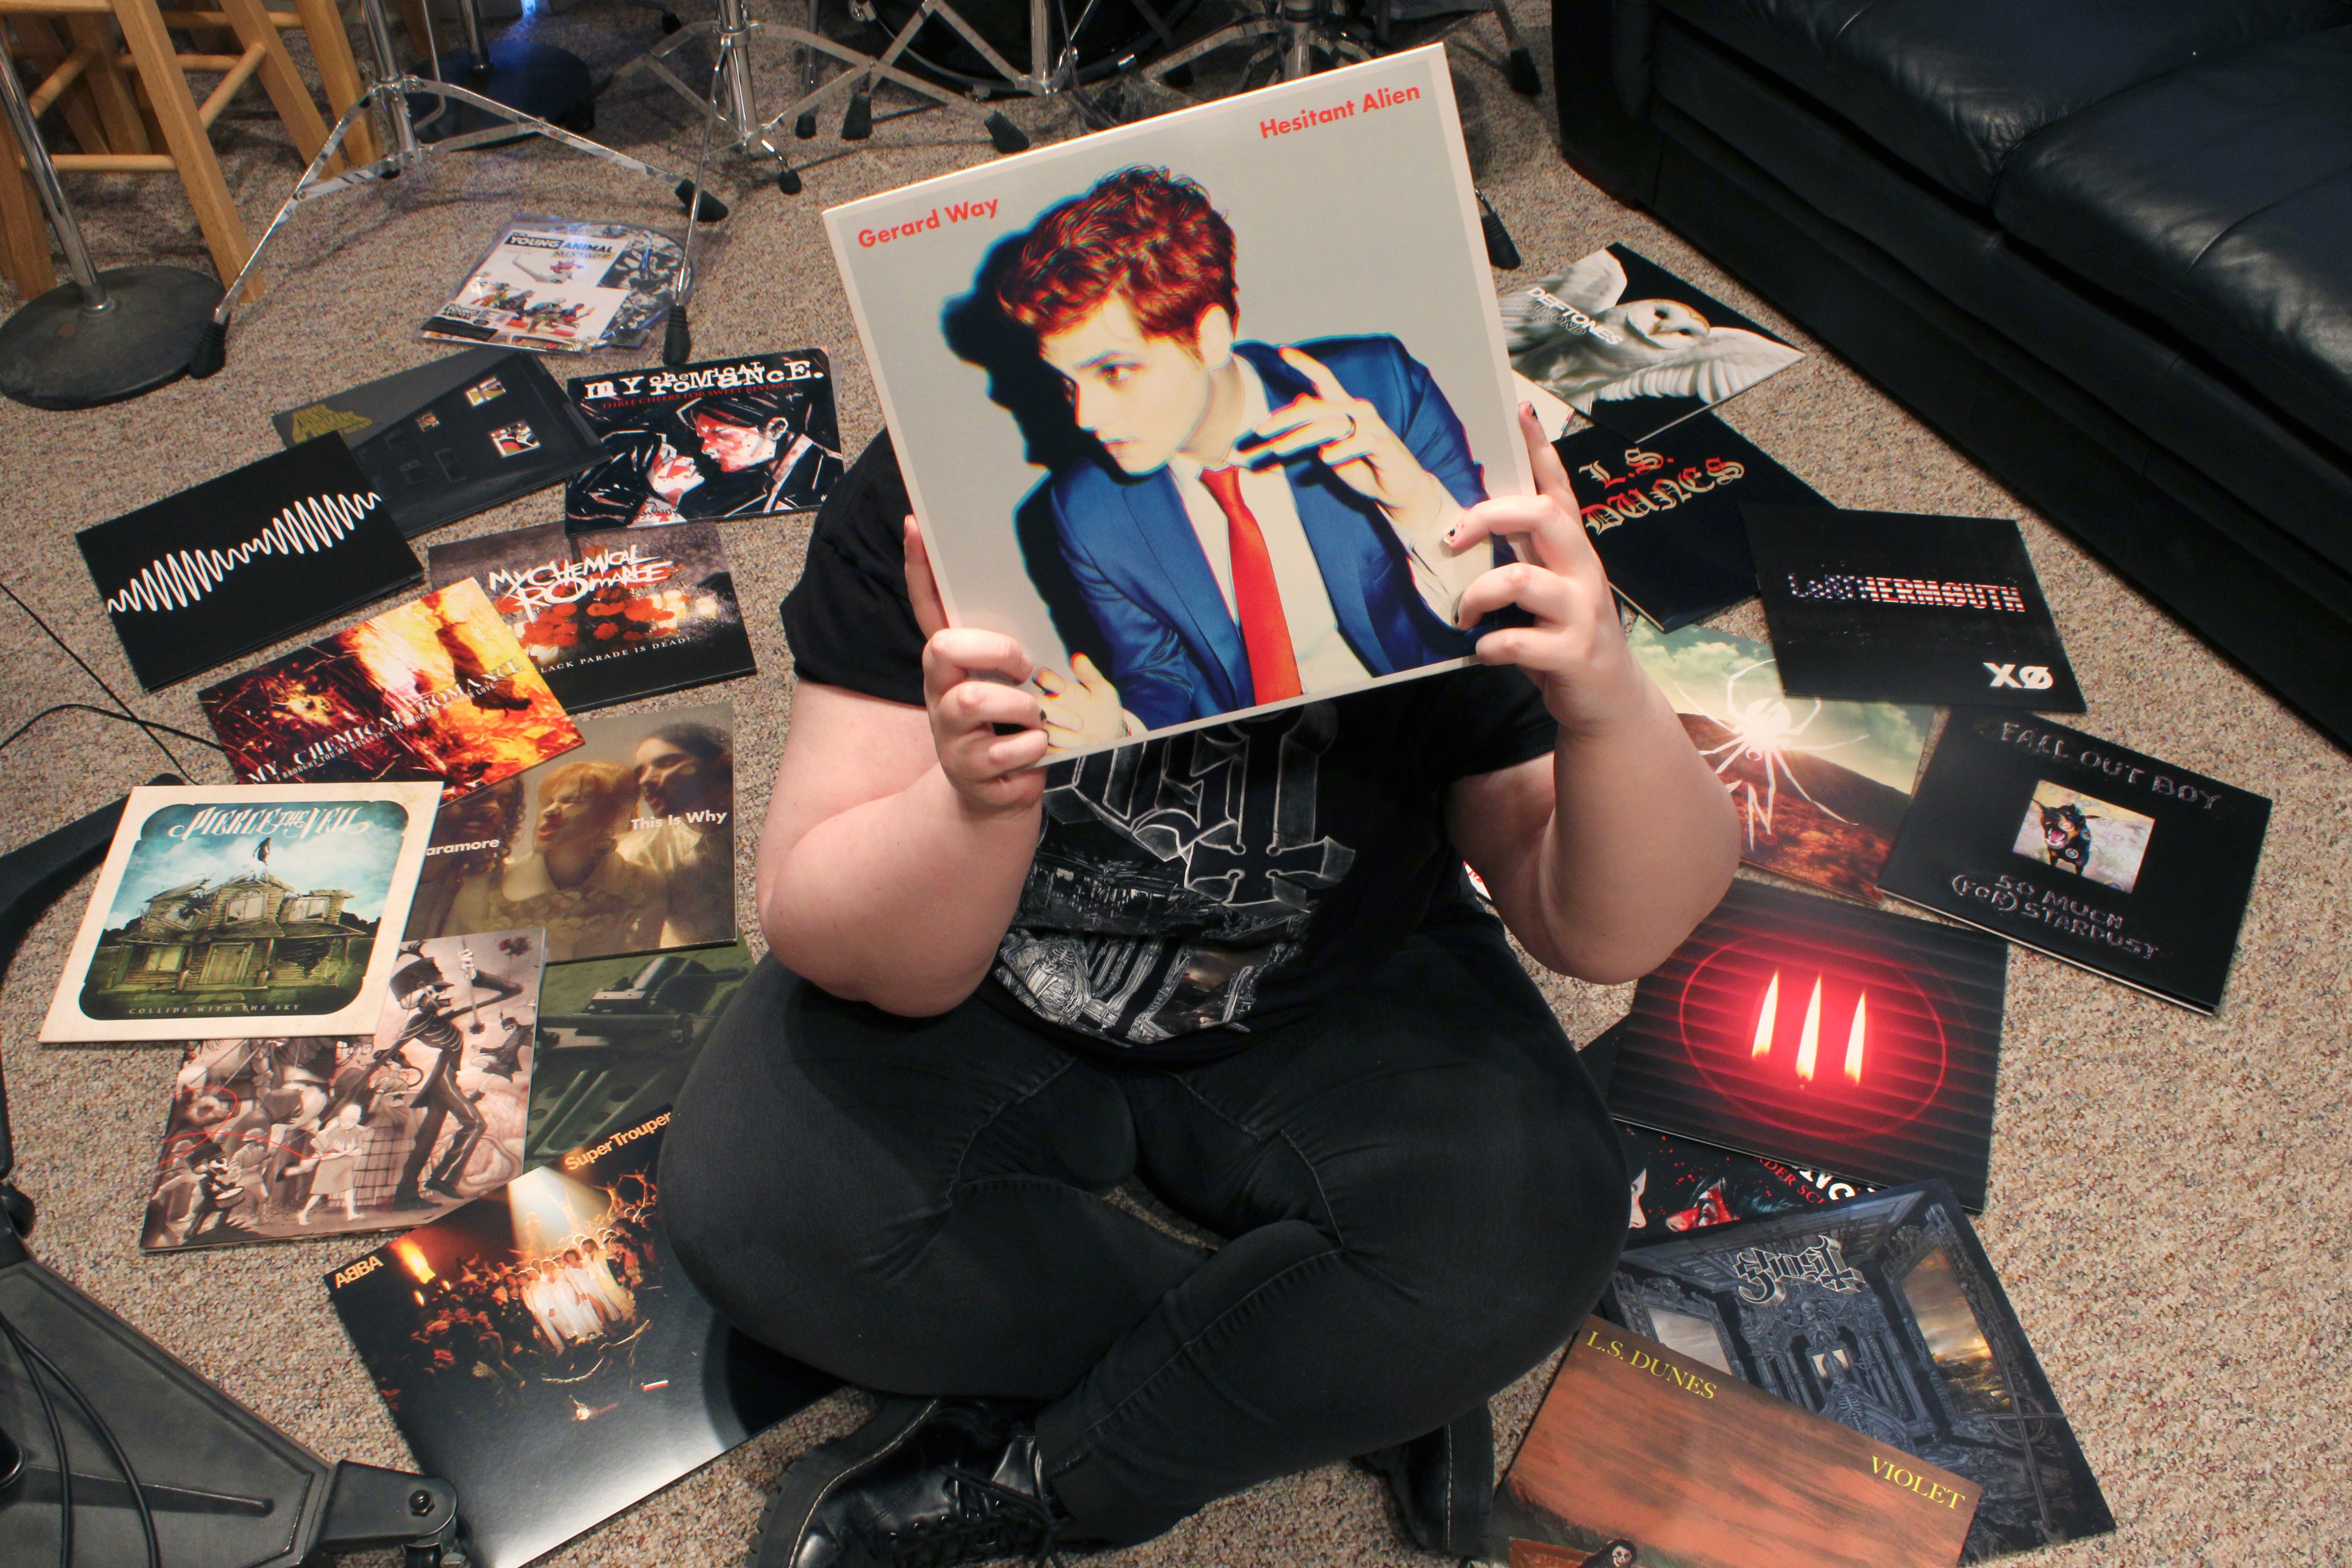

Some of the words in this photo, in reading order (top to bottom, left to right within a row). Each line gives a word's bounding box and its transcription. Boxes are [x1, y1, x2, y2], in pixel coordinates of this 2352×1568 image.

[1259, 100, 1354, 139] Hesitant
[1362, 86, 1420, 113] Alien
[511, 236, 560, 248] YOUNG
[561, 242, 612, 252] ANIMAL
[858, 208, 940, 248] Gerard
[944, 198, 998, 223] Way
[1526, 286, 1623, 345] DEFTONES
[602, 398, 636, 409] THREE
[639, 394, 681, 406] CHEERS
[684, 391, 706, 400] FOR
[708, 387, 743, 397] SWEET
[746, 382, 794, 393] REVENGE
[1579, 448, 1674, 489] L.S.
[540, 661, 575, 673] LACK
[579, 649, 629, 665] PARADE
[652, 636, 691, 650] DEAD!
[247, 761, 278, 784] MY
[293, 710, 402, 765] CHEMICAL
[416, 658, 523, 713] ROMANCE
[282, 759, 317, 779] BROUGHT
[319, 752, 336, 763] YOU
[336, 745, 349, 756] MY
[388, 722, 404, 734] YOU
[2001, 723, 2069, 759] FALL
[2081, 751, 2145, 783] OUT
[2152, 775, 2222, 810] BOY
[167, 806, 282, 841] PIERCE
[299, 806, 370, 839] VEIL
[631, 816, 663, 830] This
[668, 815, 682, 826] Is
[686, 809, 727, 824] Why
[426, 839, 501, 856] aramore
[1952, 875, 2018, 912] (FOR)
[2021, 902, 2159, 959] STARDUST
[1995, 875, 2035, 896] SO
[2042, 890, 2124, 929] MUCH
[564, 1140, 612, 1170] Super
[609, 1112, 671, 1146] Trouper
[334, 1255, 384, 1289] ABBA
[1586, 1331, 1624, 1360] L.S.
[1629, 1350, 1717, 1399] DUNES
[1872, 1455, 1966, 1509] VIOLET
